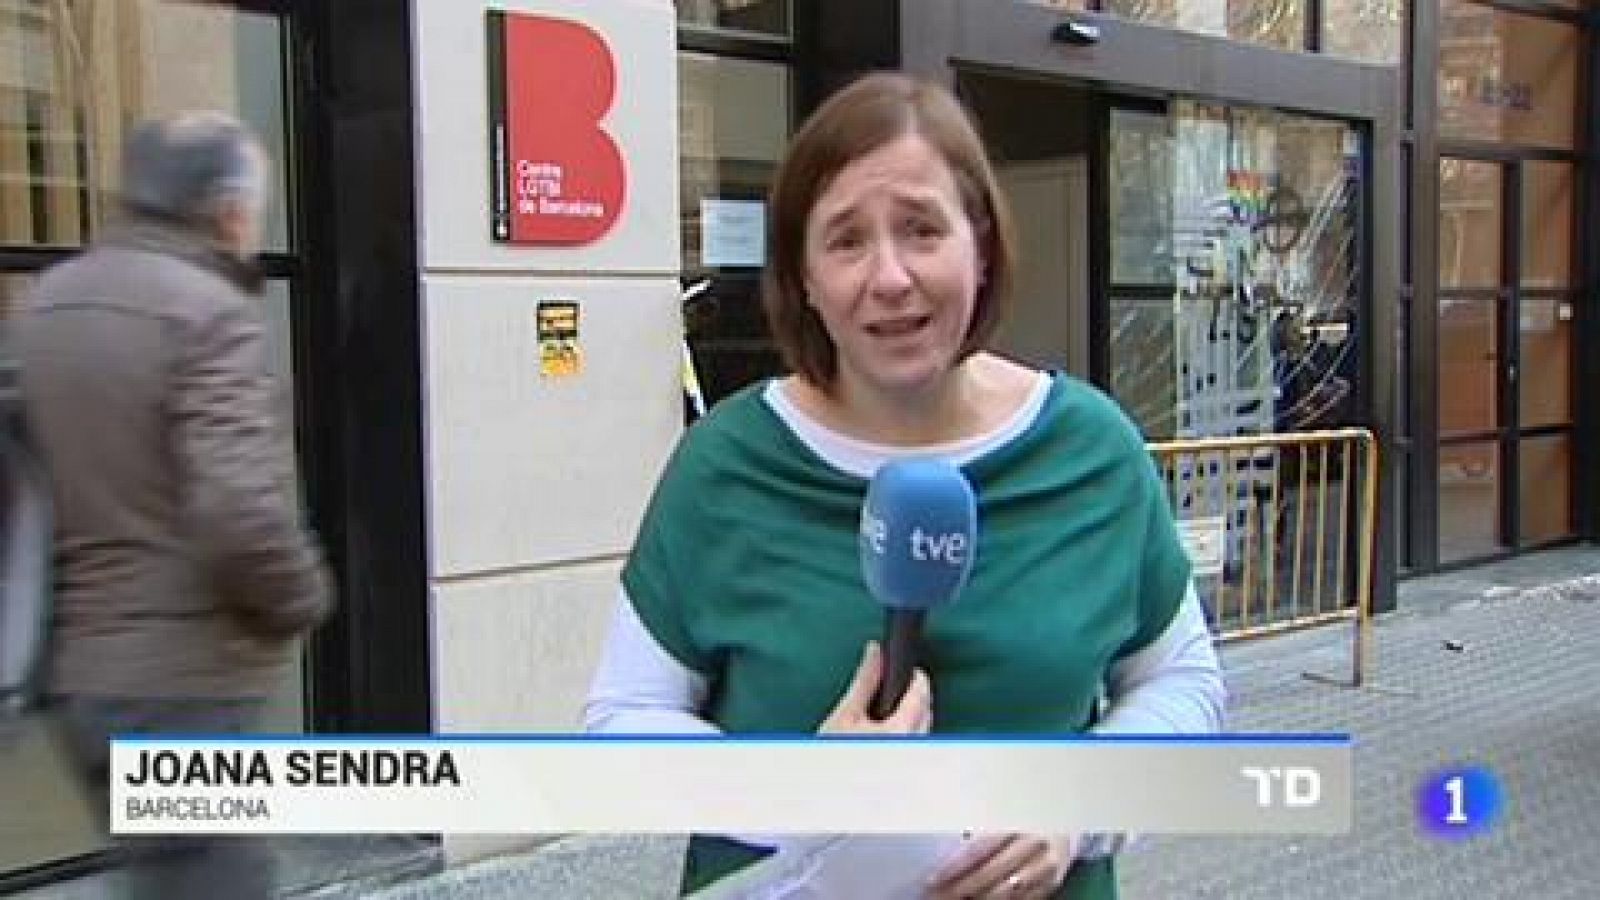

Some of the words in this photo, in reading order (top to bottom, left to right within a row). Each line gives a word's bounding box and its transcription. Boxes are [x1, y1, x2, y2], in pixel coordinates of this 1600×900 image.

[518, 198, 535, 214] de
[539, 198, 604, 217] Barcelona
[911, 527, 965, 564] tve
